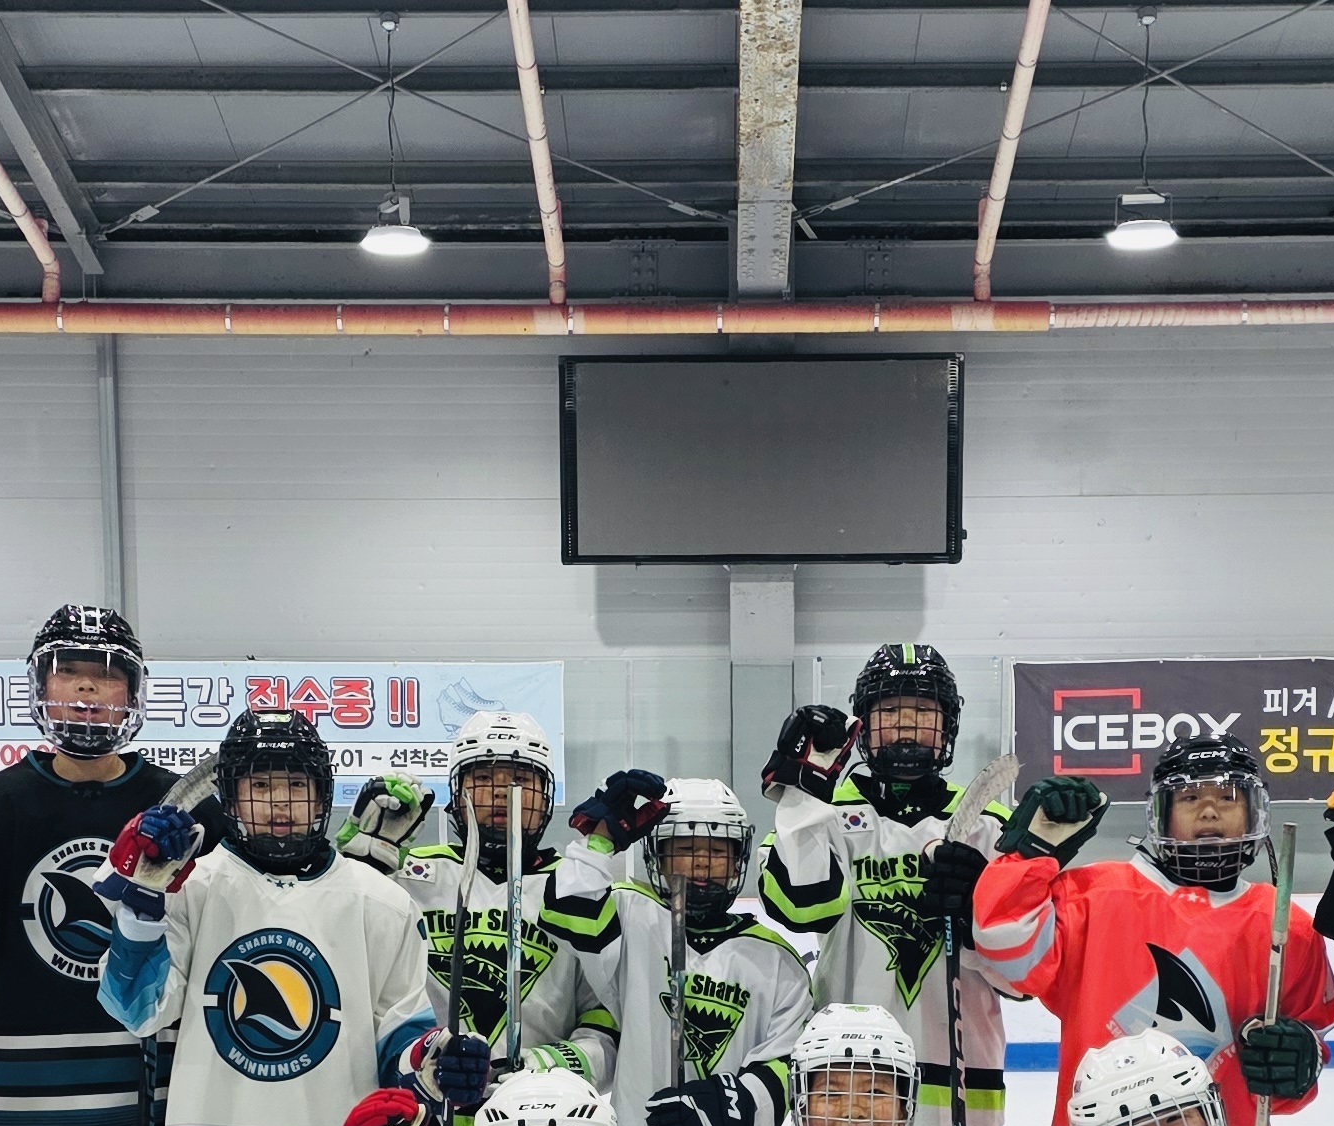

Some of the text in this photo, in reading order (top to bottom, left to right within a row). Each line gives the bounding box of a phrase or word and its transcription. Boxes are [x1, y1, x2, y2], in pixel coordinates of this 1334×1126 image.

[1262, 687, 1317, 717] 피겨
[486, 733, 522, 743] CCM
[1053, 712, 1241, 750] ICEBOX
[389, 748, 450, 768] 선착순
[1187, 750, 1227, 761] CCM
[51, 841, 97, 864] SHARKS
[237, 934, 317, 962] SHARKS MODE
[228, 1045, 313, 1077] WINNINGS
[1110, 1075, 1156, 1097] BAUER
[518, 1102, 558, 1112] CCM
